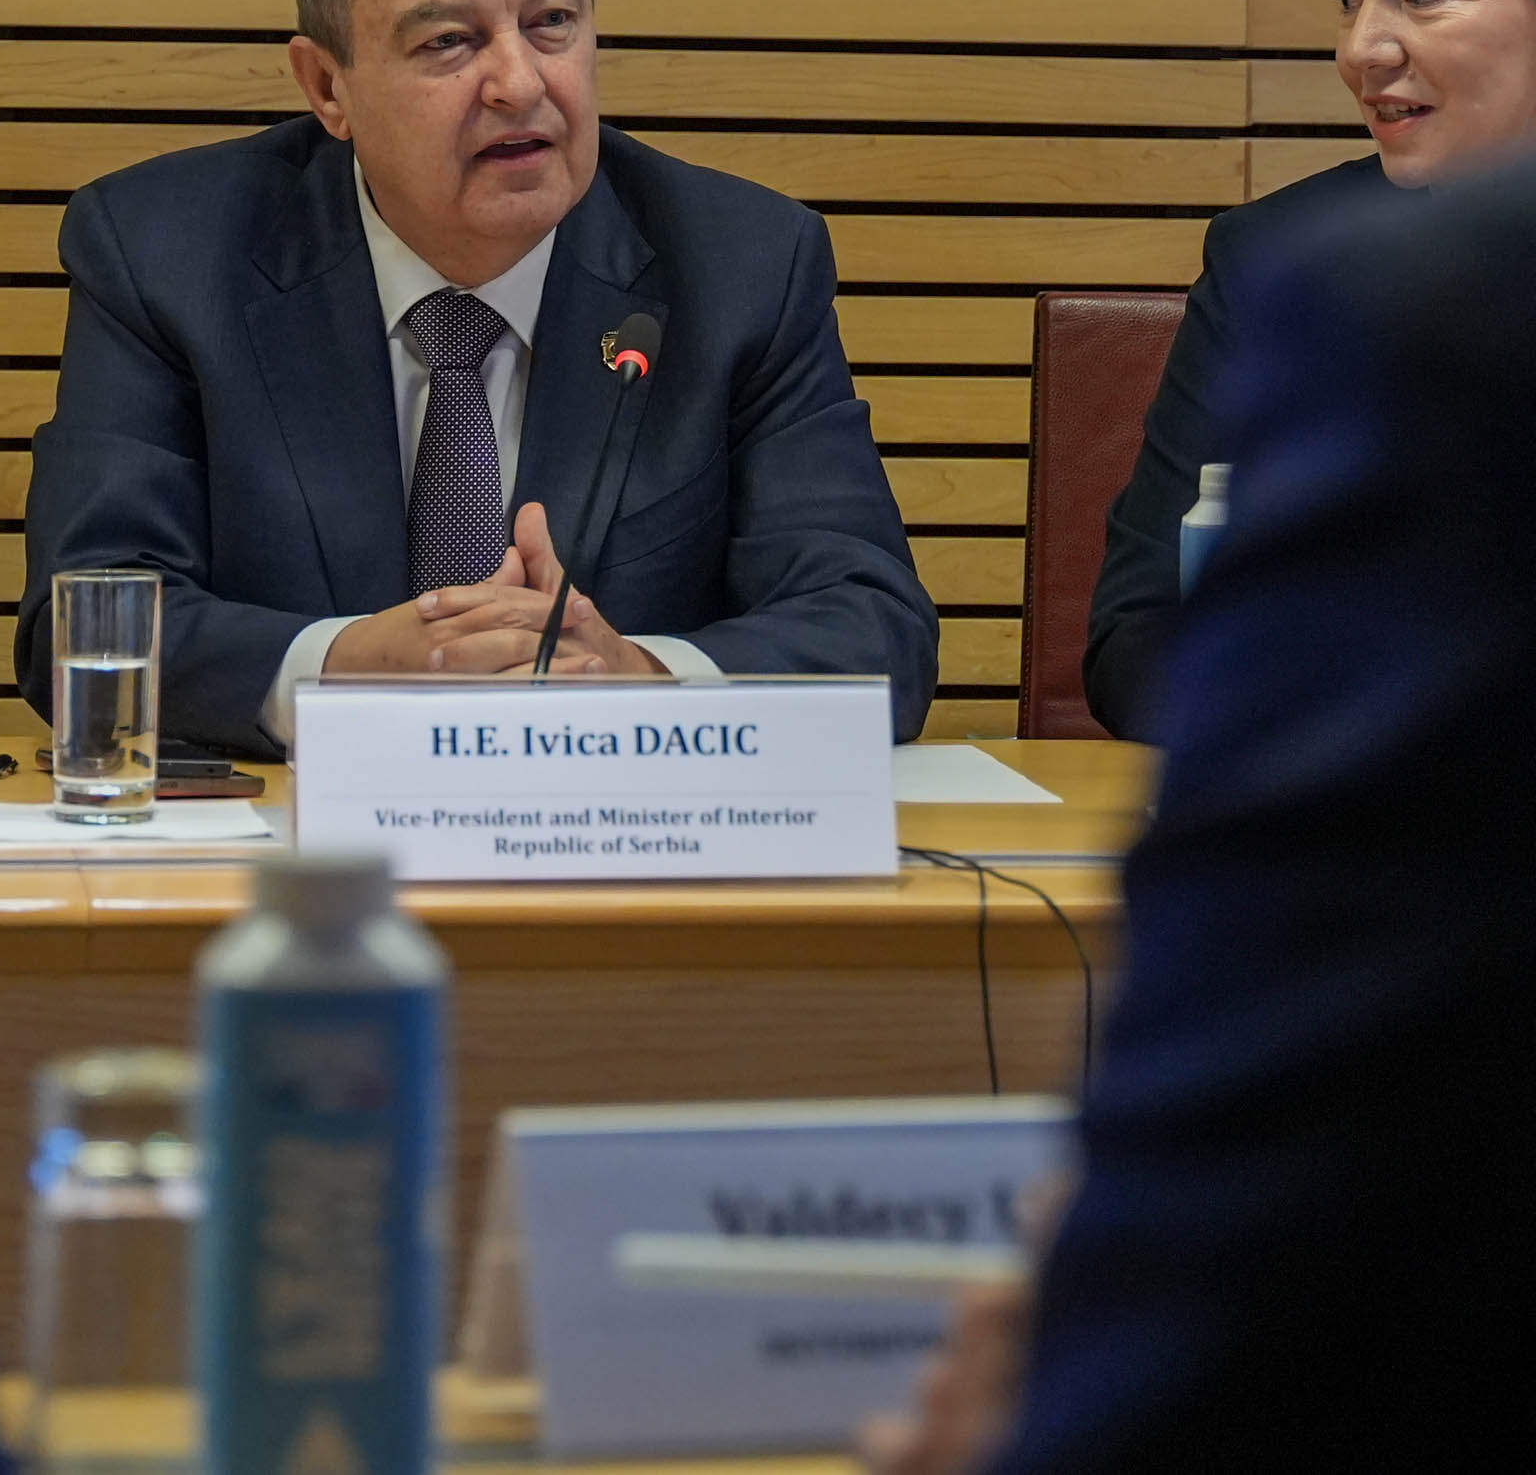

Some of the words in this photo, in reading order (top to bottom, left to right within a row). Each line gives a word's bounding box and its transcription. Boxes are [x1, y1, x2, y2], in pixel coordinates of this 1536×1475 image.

[431, 725, 509, 757] H.E.
[522, 725, 620, 757] Ivica
[632, 723, 759, 757] DACIC
[375, 808, 542, 827] Vice-President
[549, 808, 591, 826] and
[598, 807, 692, 826] Minister
[700, 807, 723, 826] of
[728, 807, 816, 826] Interior
[494, 835, 594, 859] Republic
[601, 836, 624, 854] of
[629, 835, 702, 854] Serbia
